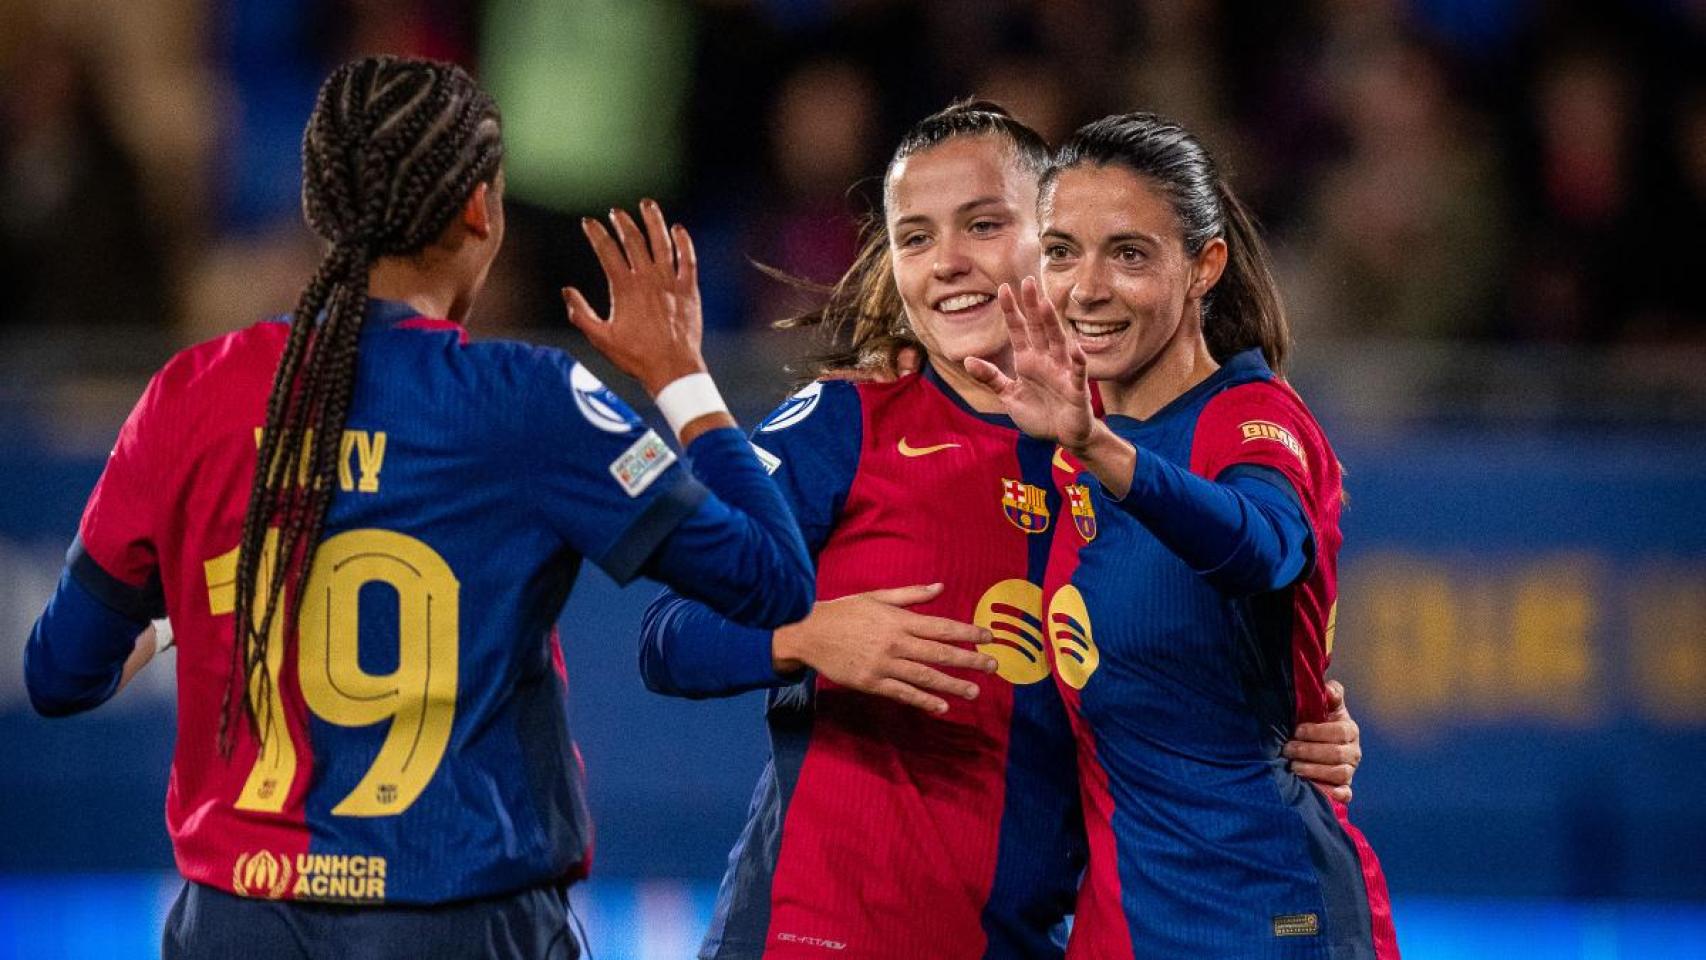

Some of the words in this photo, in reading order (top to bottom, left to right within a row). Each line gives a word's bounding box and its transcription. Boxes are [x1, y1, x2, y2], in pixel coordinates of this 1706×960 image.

[204, 527, 460, 817] 19
[296, 853, 387, 877] UNHCR
[293, 874, 385, 897] ACNUR
